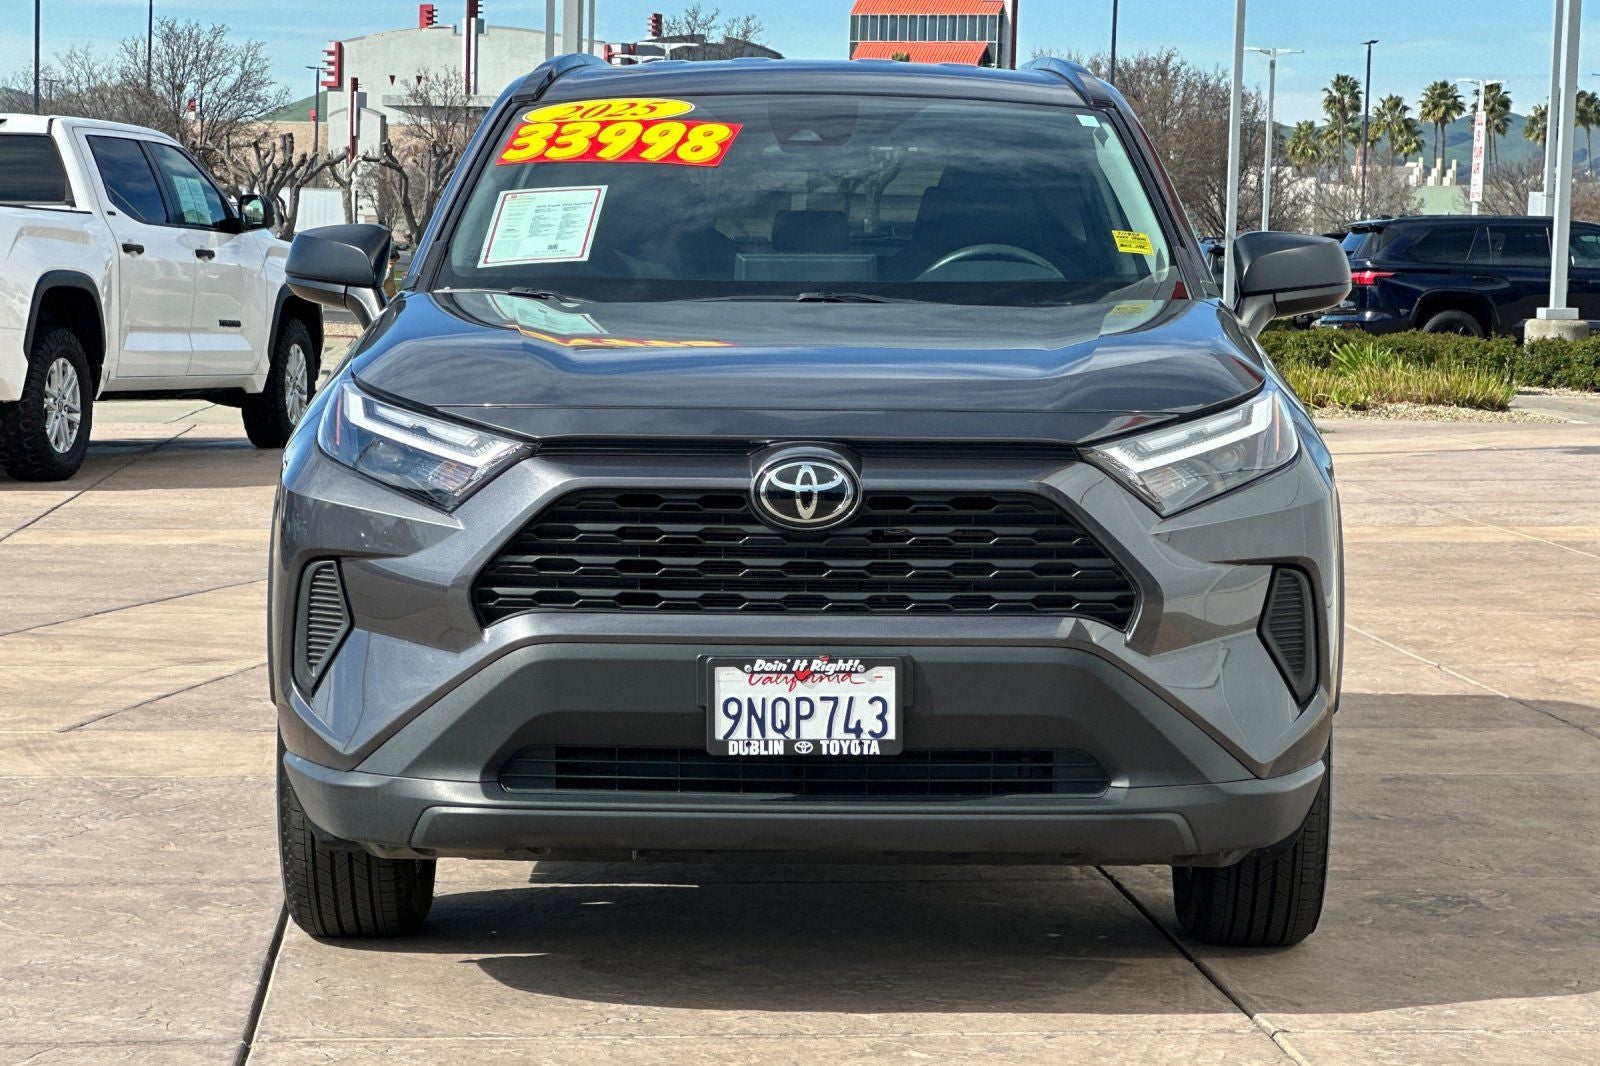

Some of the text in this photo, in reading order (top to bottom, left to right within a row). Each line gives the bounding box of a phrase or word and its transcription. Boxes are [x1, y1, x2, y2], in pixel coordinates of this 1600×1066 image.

[552, 101, 668, 121] 2025
[501, 121, 733, 163] 33998
[753, 658, 791, 673] Doin'
[792, 658, 808, 672] It
[811, 659, 861, 676] Right!
[748, 672, 866, 692] Califrnia
[722, 695, 888, 740] 9NQP743
[728, 740, 881, 756] DUBLIN TOYOTA
